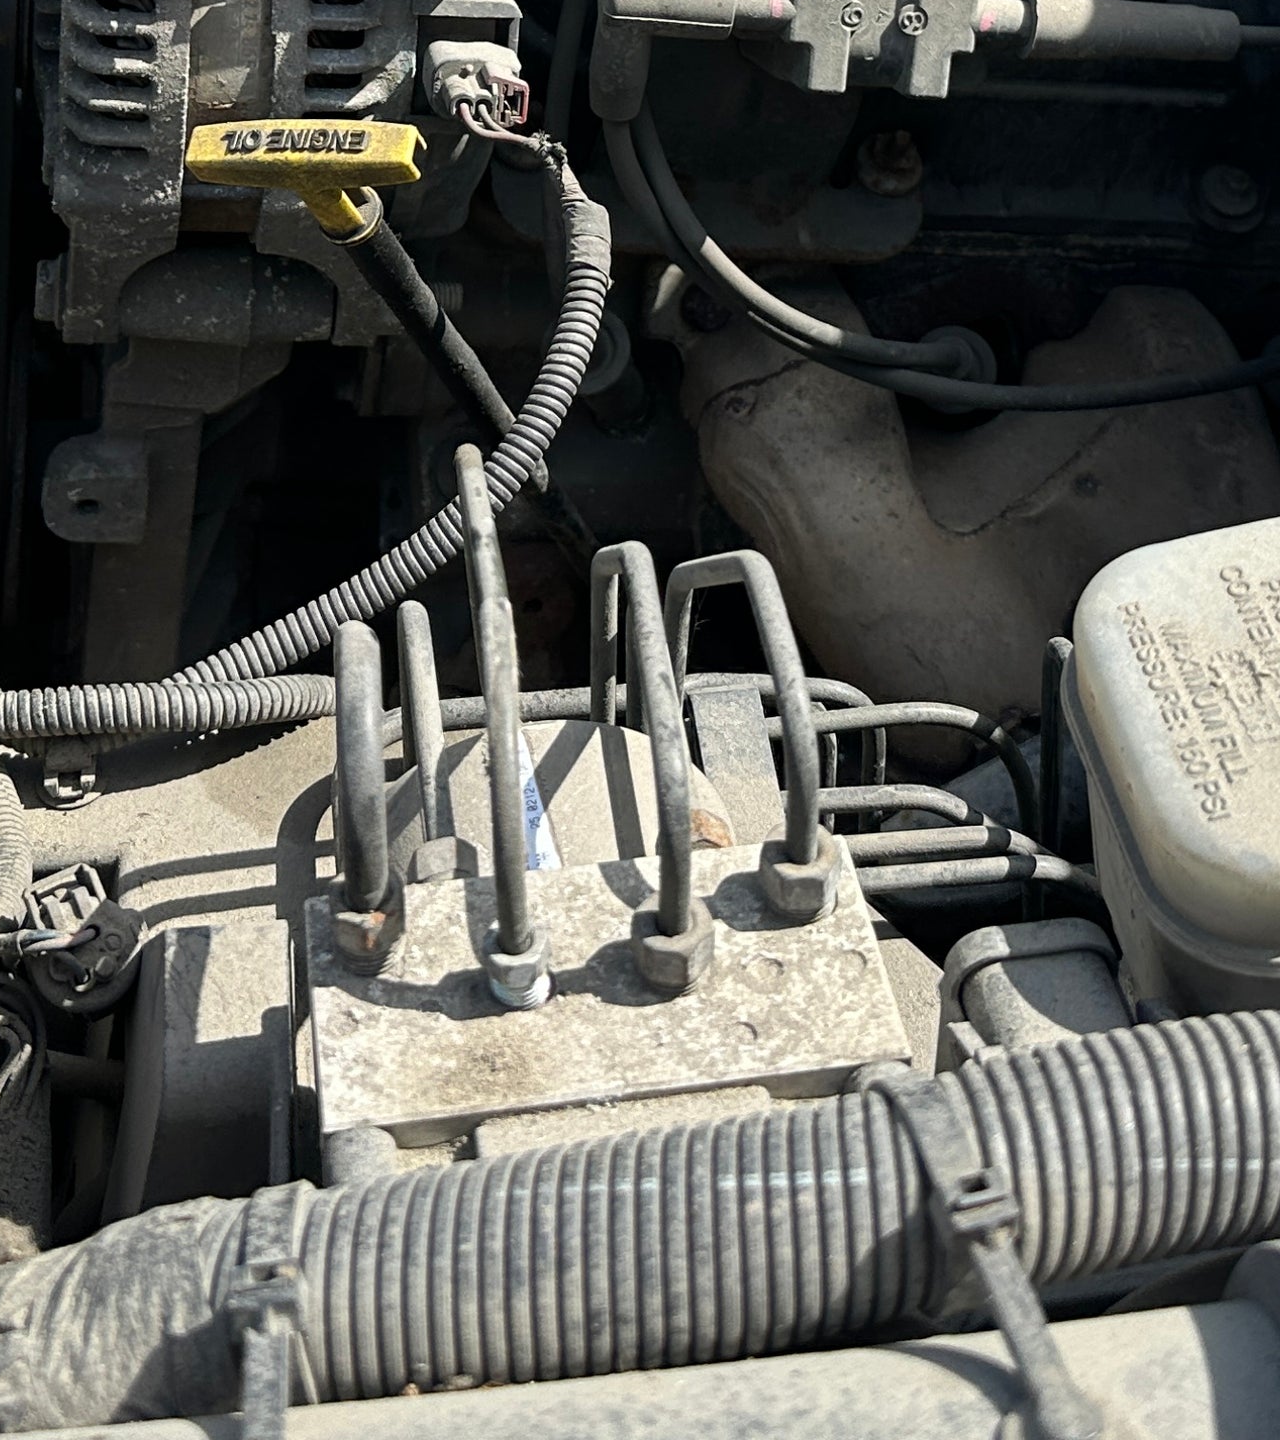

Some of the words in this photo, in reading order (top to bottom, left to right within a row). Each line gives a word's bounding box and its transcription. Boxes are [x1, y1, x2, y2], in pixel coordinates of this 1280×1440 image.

[842, 4, 861, 29] 6
[902, 9, 923, 33] 3
[219, 130, 262, 154] OIL
[258, 130, 366, 156] ENGINE
[1120, 604, 1191, 733] PRESSURE:
[1195, 781, 1230, 823] PSI
[1161, 622, 1228, 734] MAXIMUM
[1211, 737, 1249, 786] FILL
